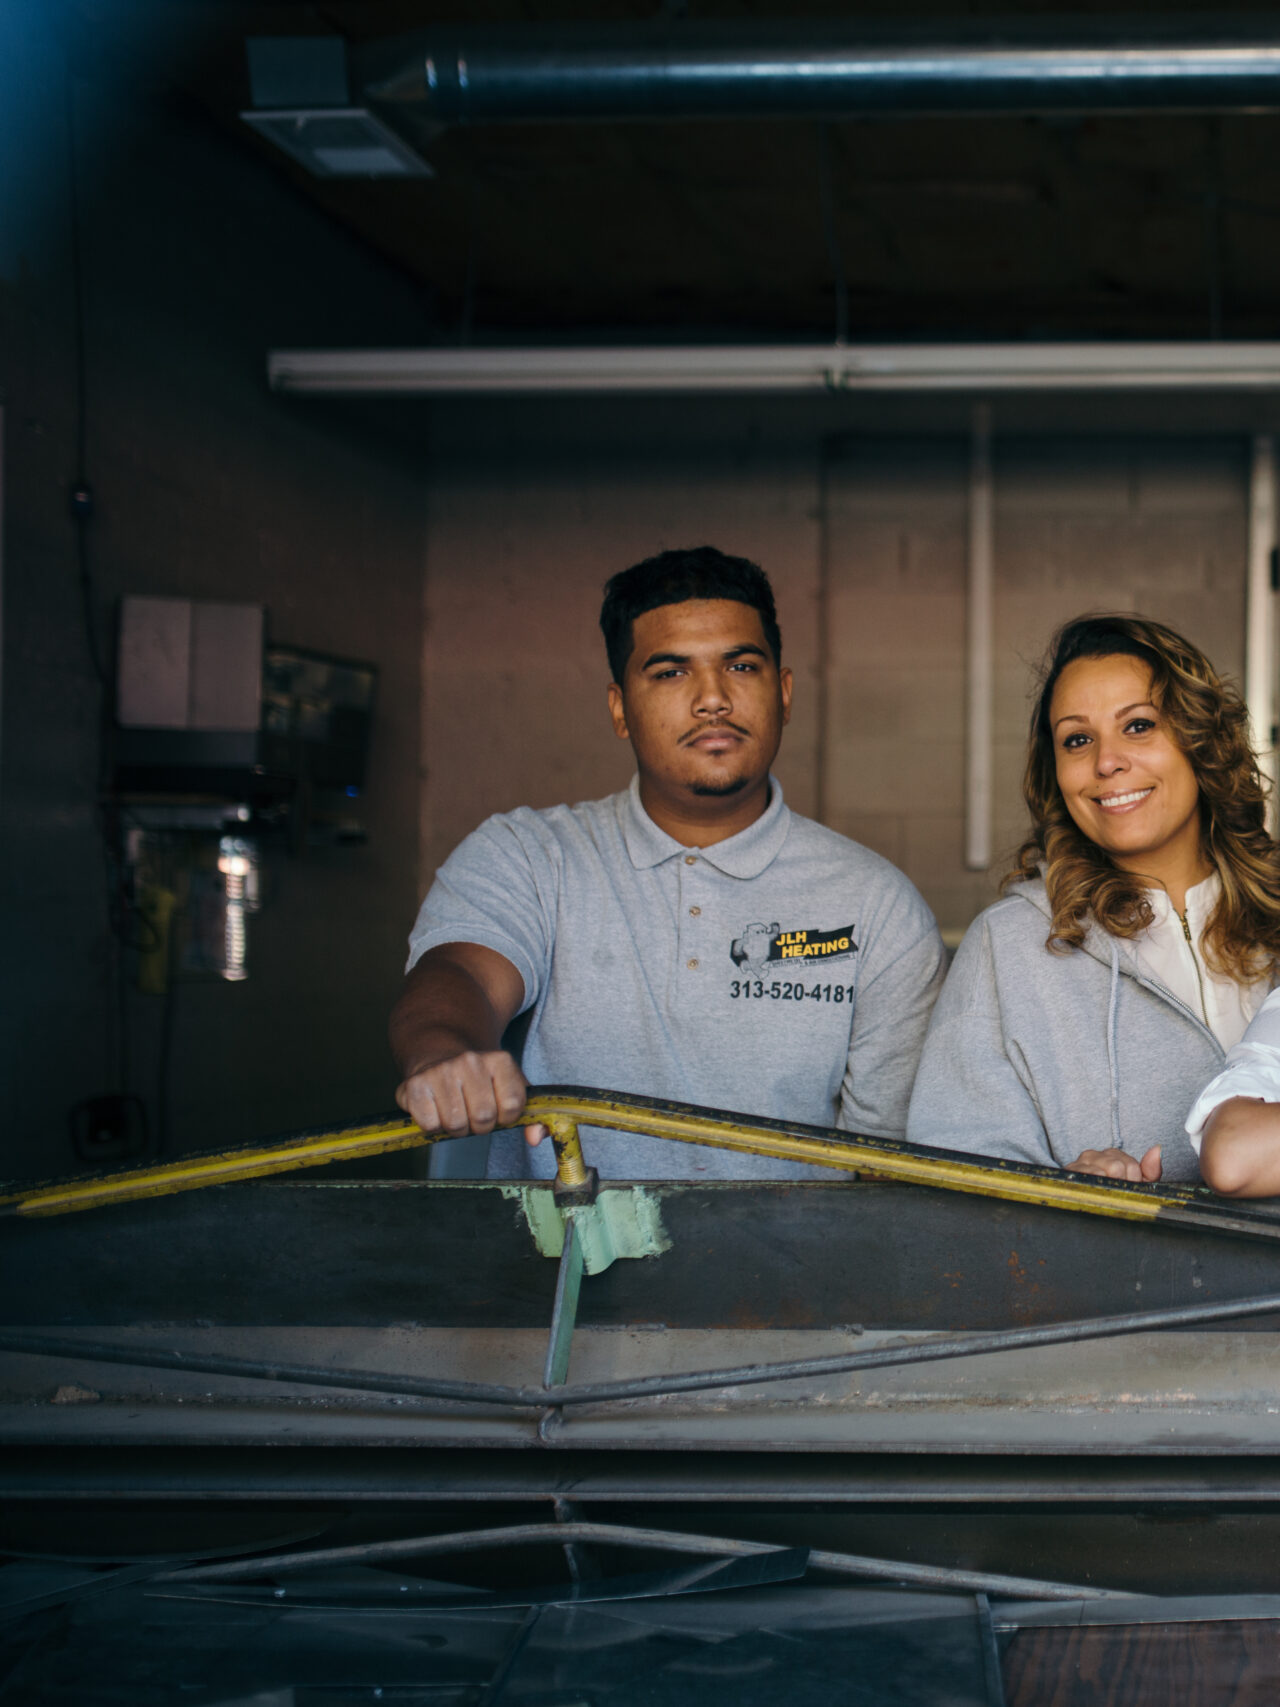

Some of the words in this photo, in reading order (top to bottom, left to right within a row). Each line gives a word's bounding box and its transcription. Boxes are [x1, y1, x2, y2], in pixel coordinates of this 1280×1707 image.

[776, 931, 807, 946] JLH
[781, 937, 849, 959] HEATING
[730, 980, 855, 1004] 313-520-4181
